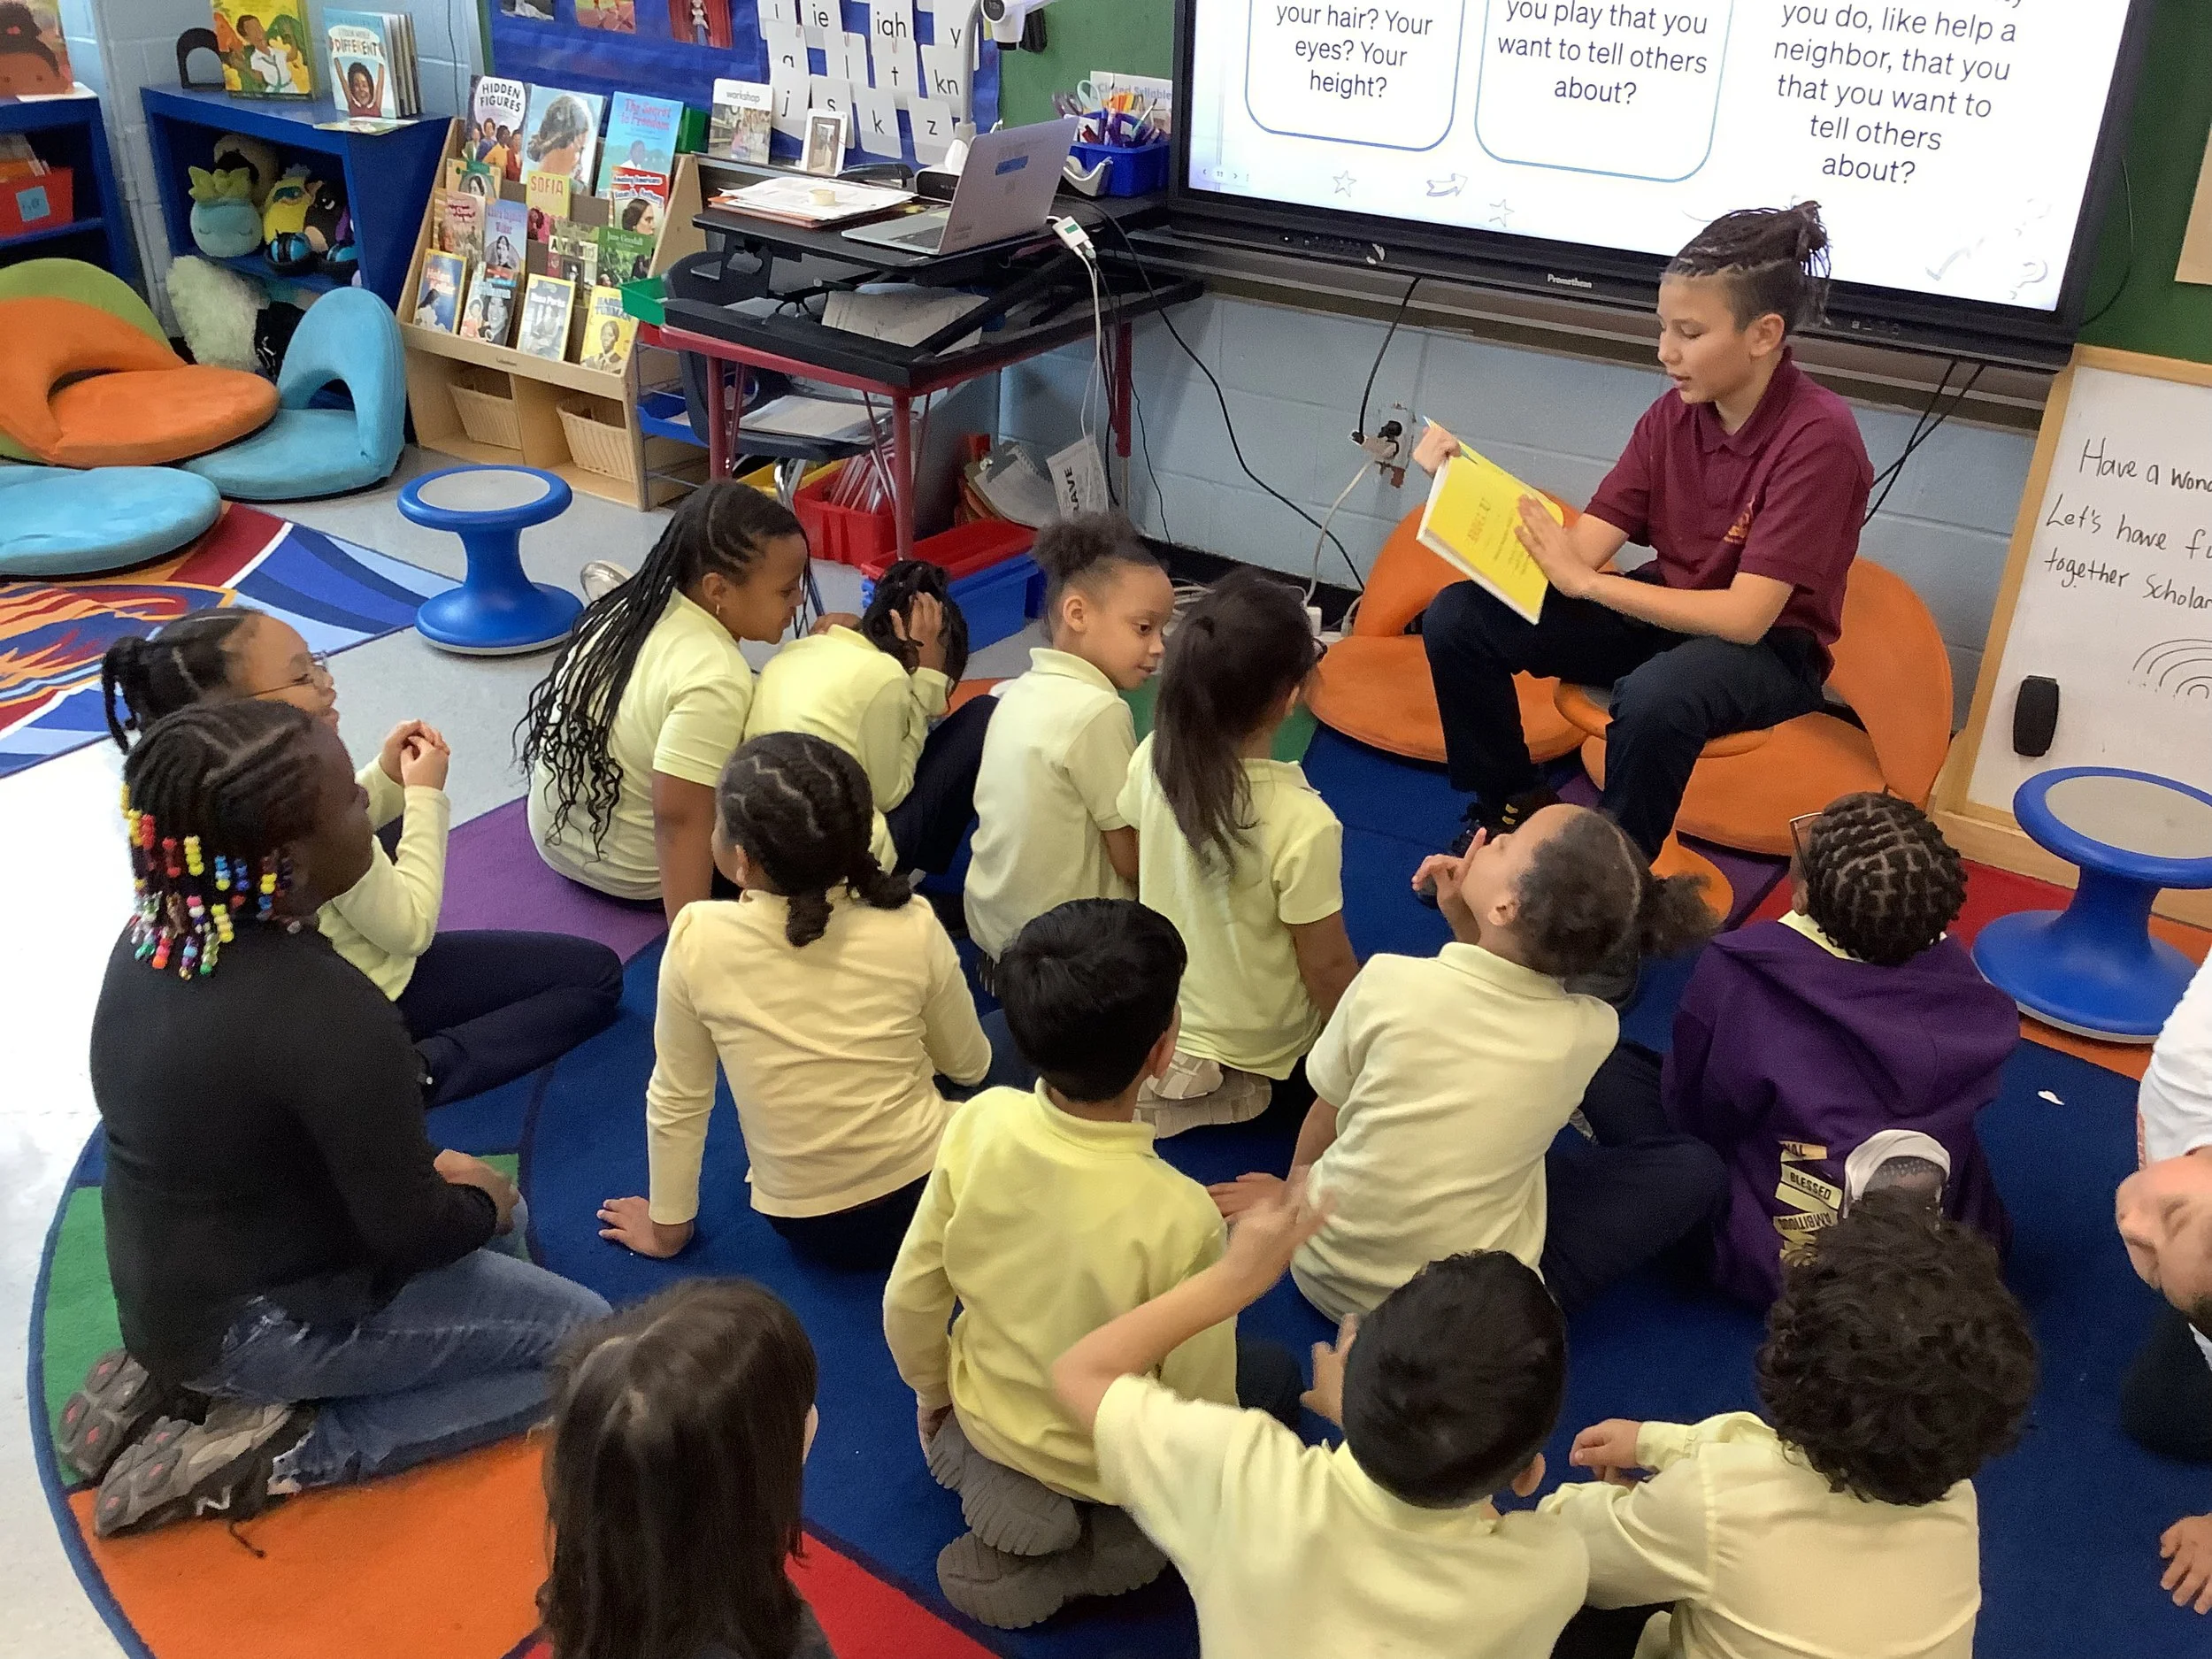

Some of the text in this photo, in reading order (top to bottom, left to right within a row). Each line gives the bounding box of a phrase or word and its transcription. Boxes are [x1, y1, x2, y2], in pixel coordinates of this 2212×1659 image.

[812, 4, 829, 27] ie
[1277, 4, 1433, 35] your hair? Your
[1506, 0, 1707, 36] you play that you
[1781, 4, 2016, 44] you do, like help a
[950, 28, 962, 49] y
[1295, 40, 1408, 66] eyes? Your
[1498, 37, 1708, 73] want to tell others
[1774, 39, 2010, 82] neighbor, that you
[891, 66, 899, 86] t
[934, 69, 960, 95] kn
[1098, 83, 1132, 94] Clsed
[1310, 69, 1387, 99] height?
[1555, 76, 1637, 104] about?
[480, 96, 521, 112] FIGURES
[482, 83, 521, 99] HIDDEN
[726, 90, 761, 104] workshop
[782, 90, 791, 117] j
[1778, 74, 1992, 117] that you want to
[872, 110, 885, 134] k
[927, 120, 938, 136] z
[1810, 115, 1942, 150] tell others
[1823, 153, 1916, 183] about?
[531, 175, 564, 195] SOFIA
[2079, 437, 2138, 478] Have
[2147, 464, 2160, 485] a
[2046, 493, 2101, 534] Let's
[2116, 514, 2167, 550] have
[2044, 547, 2131, 588] together
[1790, 1171, 1832, 1201] BLESSED
